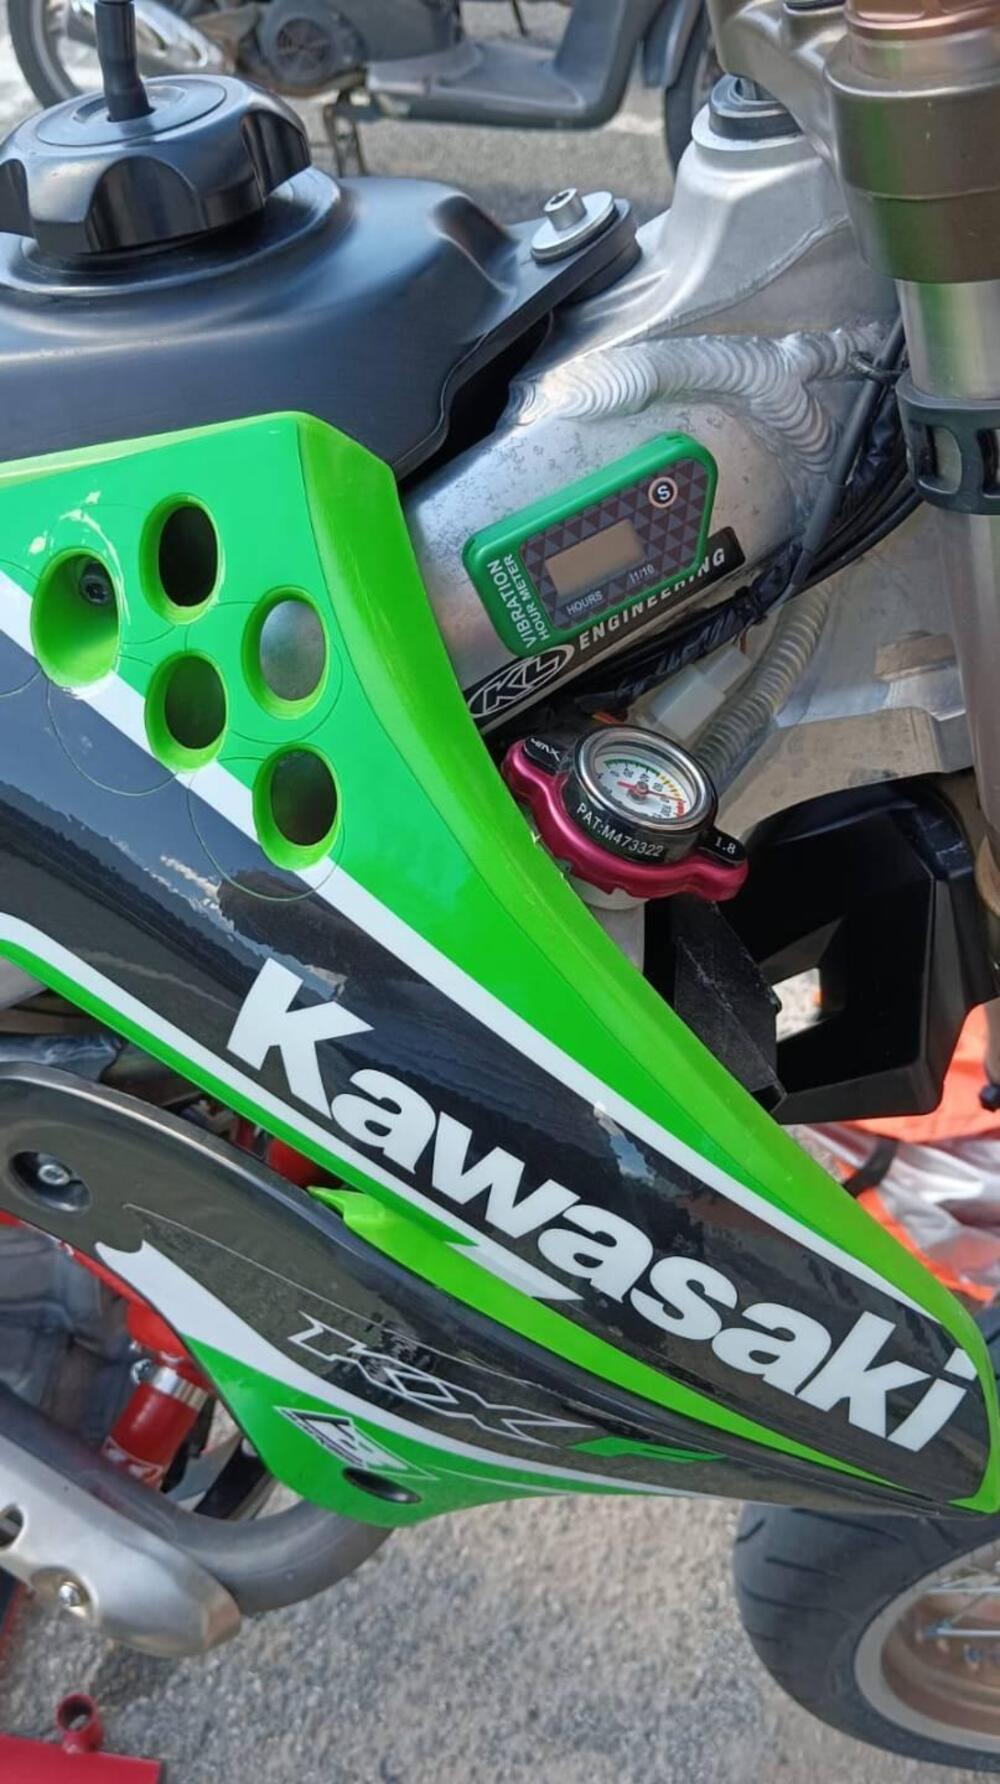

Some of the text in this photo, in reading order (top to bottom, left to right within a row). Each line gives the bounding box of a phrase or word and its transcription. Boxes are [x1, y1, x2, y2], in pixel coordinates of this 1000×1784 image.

[656, 484, 671, 500] S
[486, 559, 537, 648] VIBRATION
[504, 554, 550, 640] HOUR METER
[566, 590, 603, 615] HOURS
[482, 655, 561, 715] KL
[577, 802, 664, 857] PAT:M473322
[715, 837, 737, 854] 1.8
[227, 958, 977, 1451] Kawasaki
